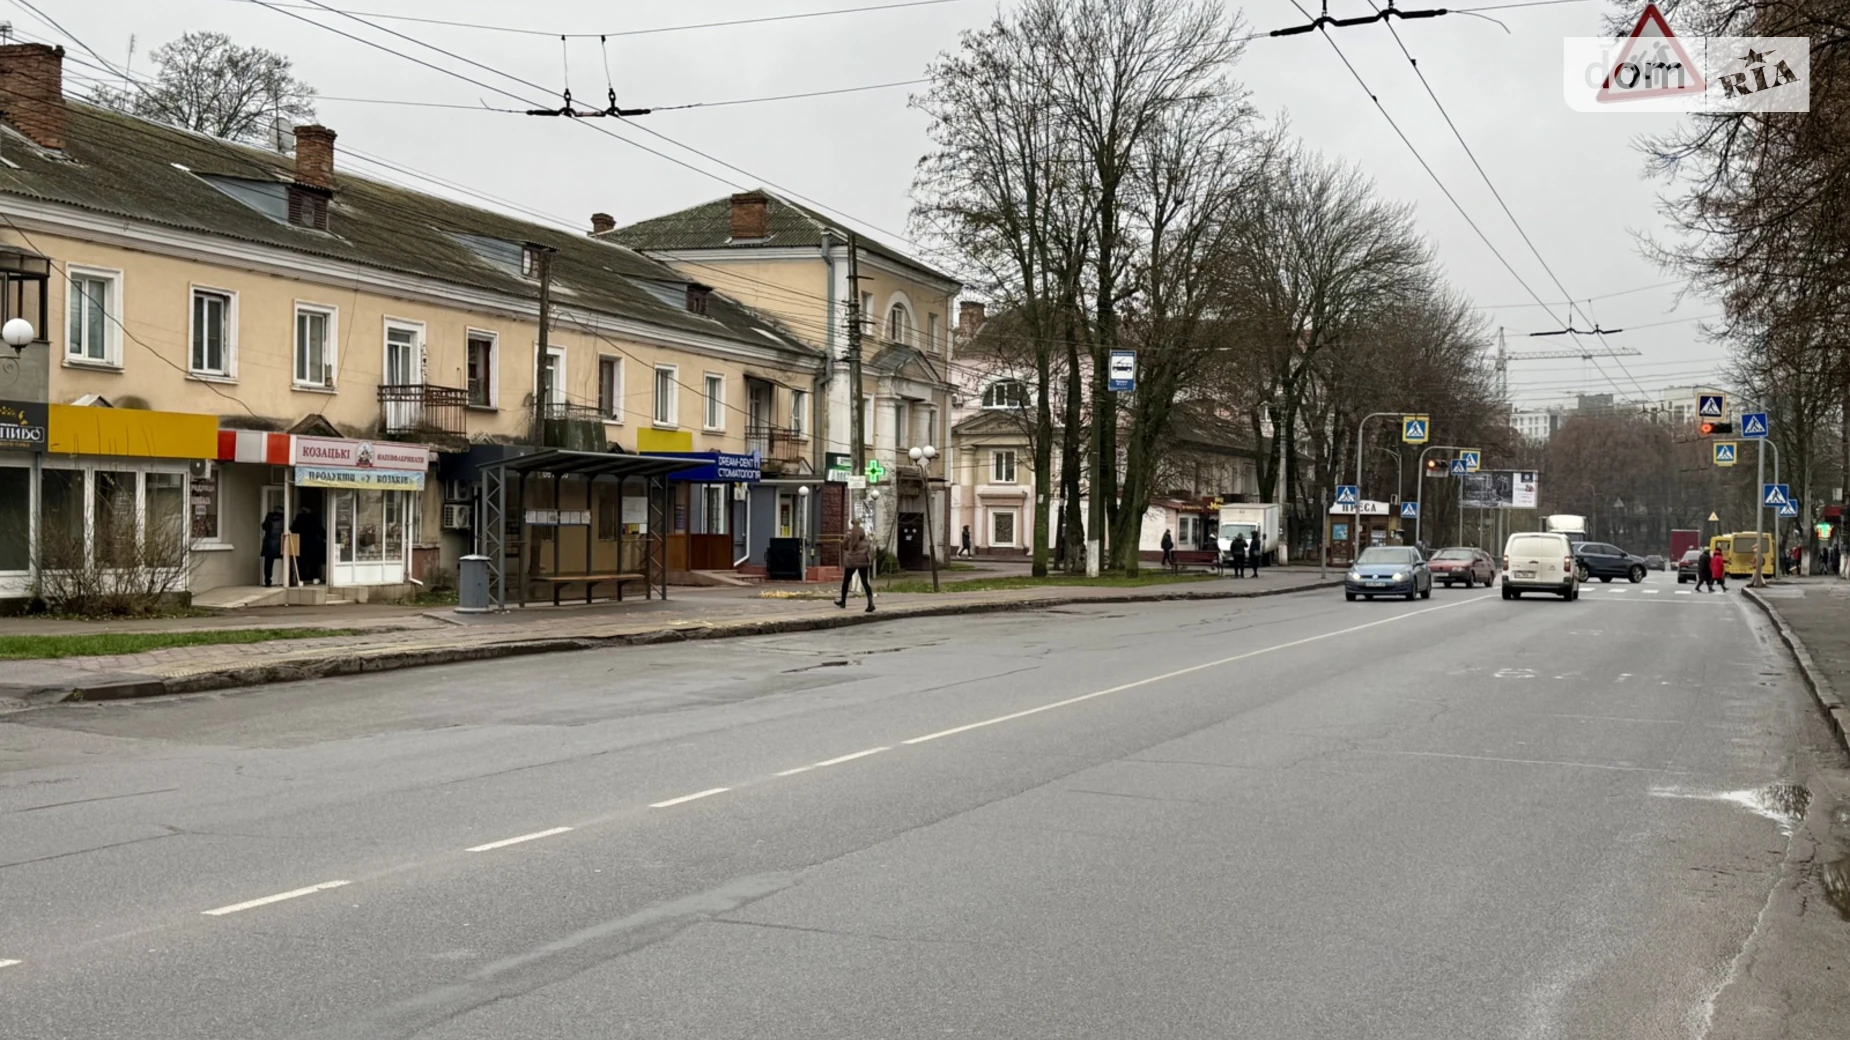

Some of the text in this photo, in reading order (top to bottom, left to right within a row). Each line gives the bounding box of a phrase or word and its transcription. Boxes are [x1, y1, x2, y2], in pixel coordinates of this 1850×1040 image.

[303, 446, 425, 464] КОЗАЦЬКІ НАПІВФАБРИКАТИ
[718, 456, 754, 468] DREAM-DENT
[308, 471, 356, 482] ПРОДУКТИ
